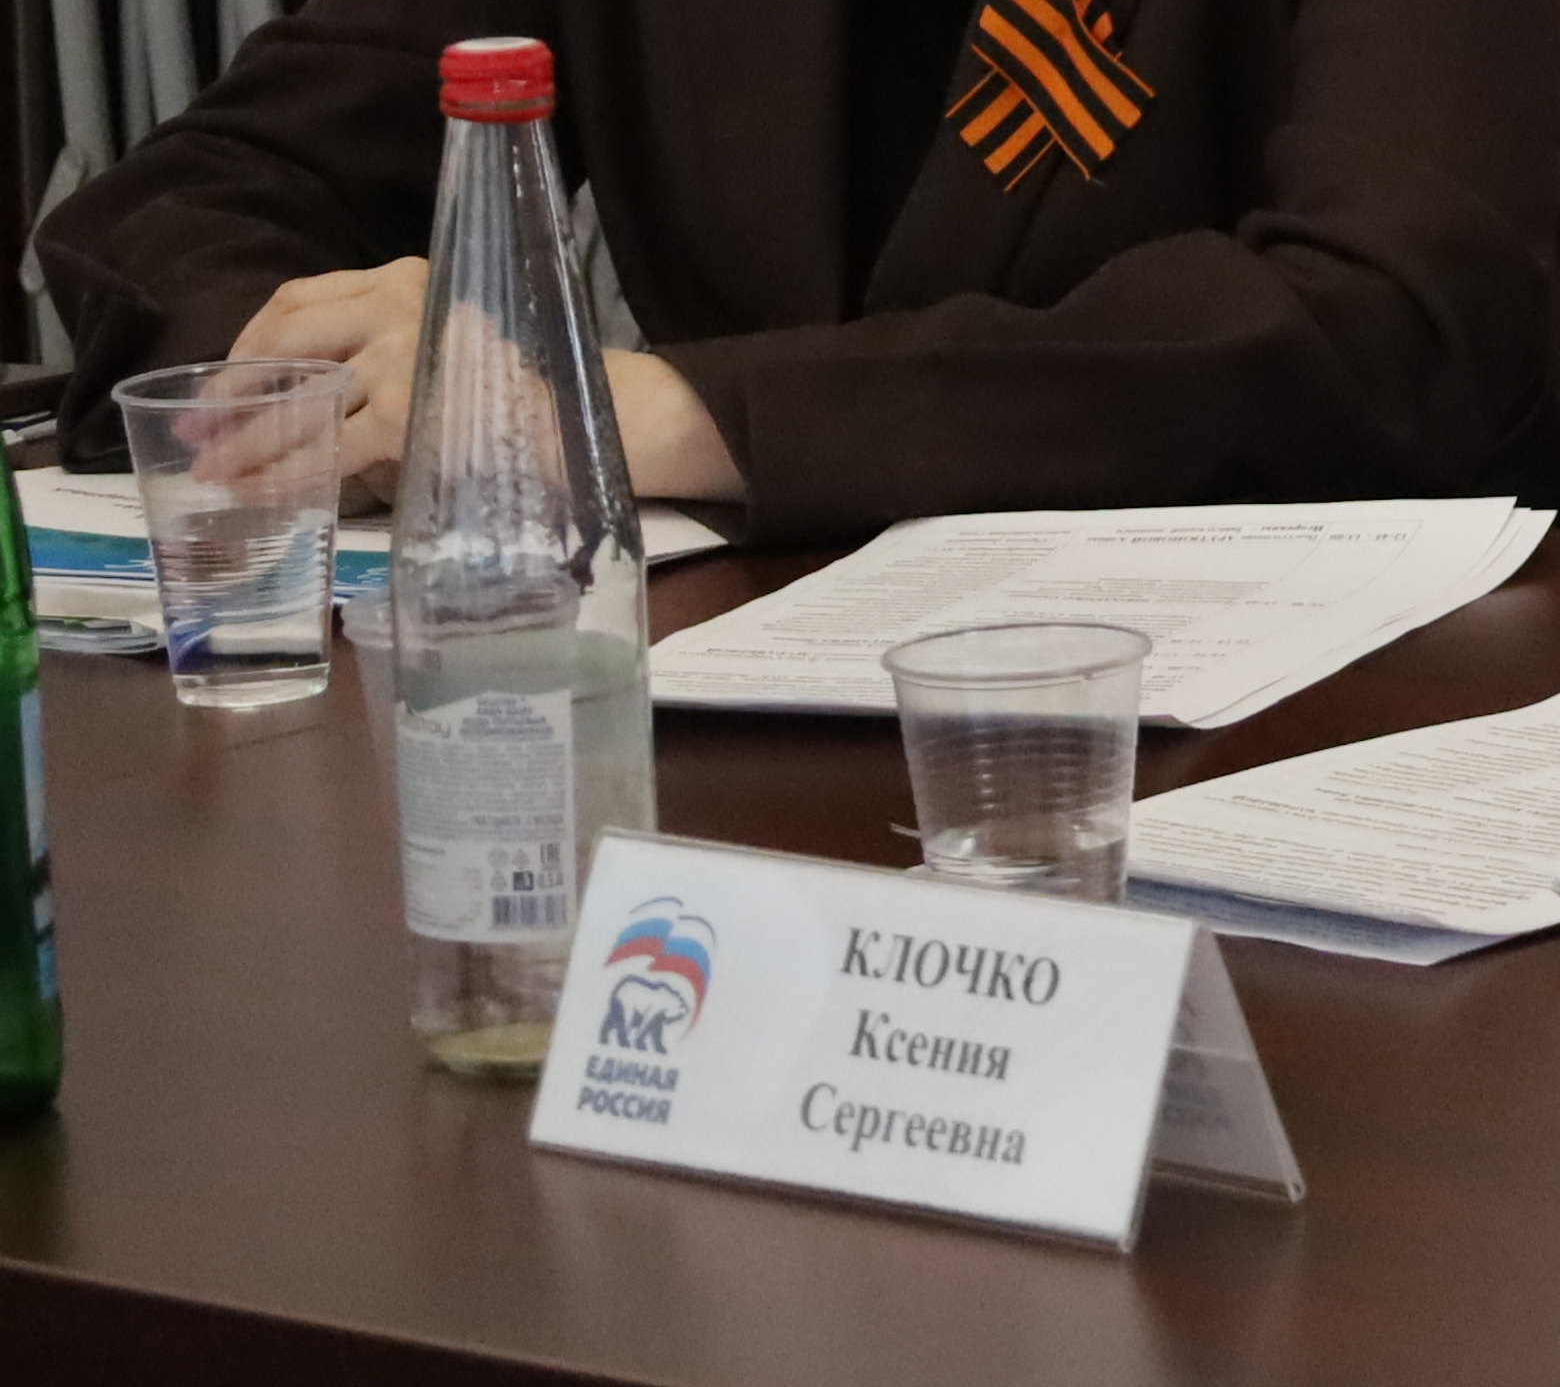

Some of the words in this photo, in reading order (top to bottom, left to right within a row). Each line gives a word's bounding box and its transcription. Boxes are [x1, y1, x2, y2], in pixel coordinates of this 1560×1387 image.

[841, 927, 1060, 1006] КЛОЧКО
[585, 1054, 679, 1093] ЕДИНАЯ
[848, 1008, 1012, 1081] Ксения
[576, 1086, 673, 1125] РОССИЯ
[800, 1082, 1027, 1166] Сергеевна
